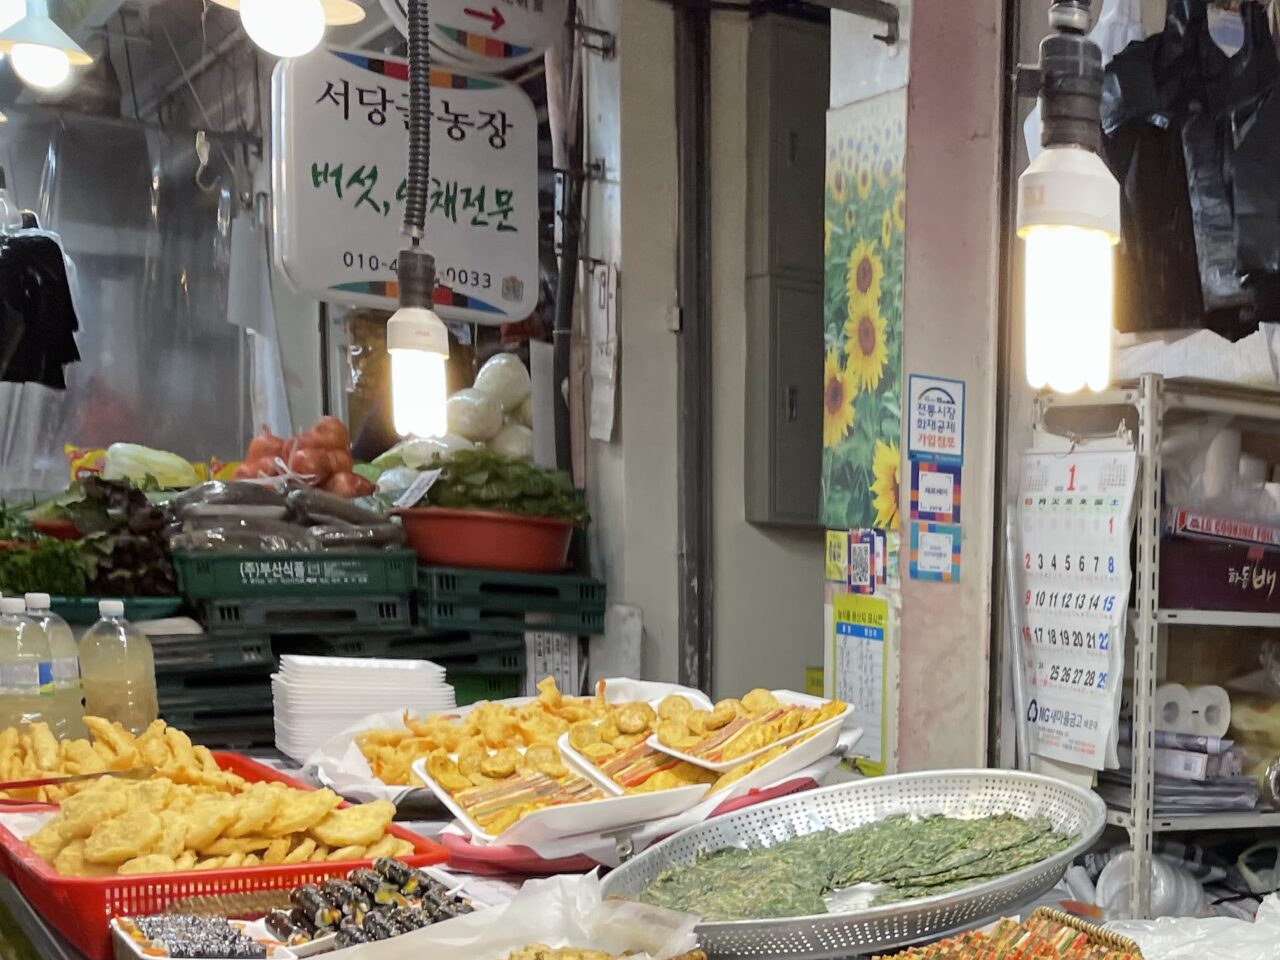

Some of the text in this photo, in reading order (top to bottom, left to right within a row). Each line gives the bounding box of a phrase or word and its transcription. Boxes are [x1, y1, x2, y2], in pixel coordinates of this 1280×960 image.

[917, 403, 956, 421] 전통시장
[916, 419, 956, 434] 화재공제
[1067, 464, 1076, 491] 1
[1108, 516, 1114, 534] 1
[1025, 553, 1114, 573] 2 3 4 5 6 7 8
[1035, 591, 1046, 606] 10
[1049, 591, 1058, 608] 11
[1061, 592, 1073, 609] 12
[1074, 593, 1087, 609] 13
[1088, 594, 1101, 610] 14
[1103, 596, 1115, 612] 15
[1034, 628, 1043, 643] 17
[1047, 629, 1057, 645] 18
[1060, 630, 1070, 646] 19
[1072, 631, 1083, 647] 20
[1086, 633, 1096, 649] 21
[1050, 665, 1060, 680] 25
[1060, 667, 1072, 682] 26
[1072, 669, 1083, 685] 27
[1084, 670, 1095, 687] 28
